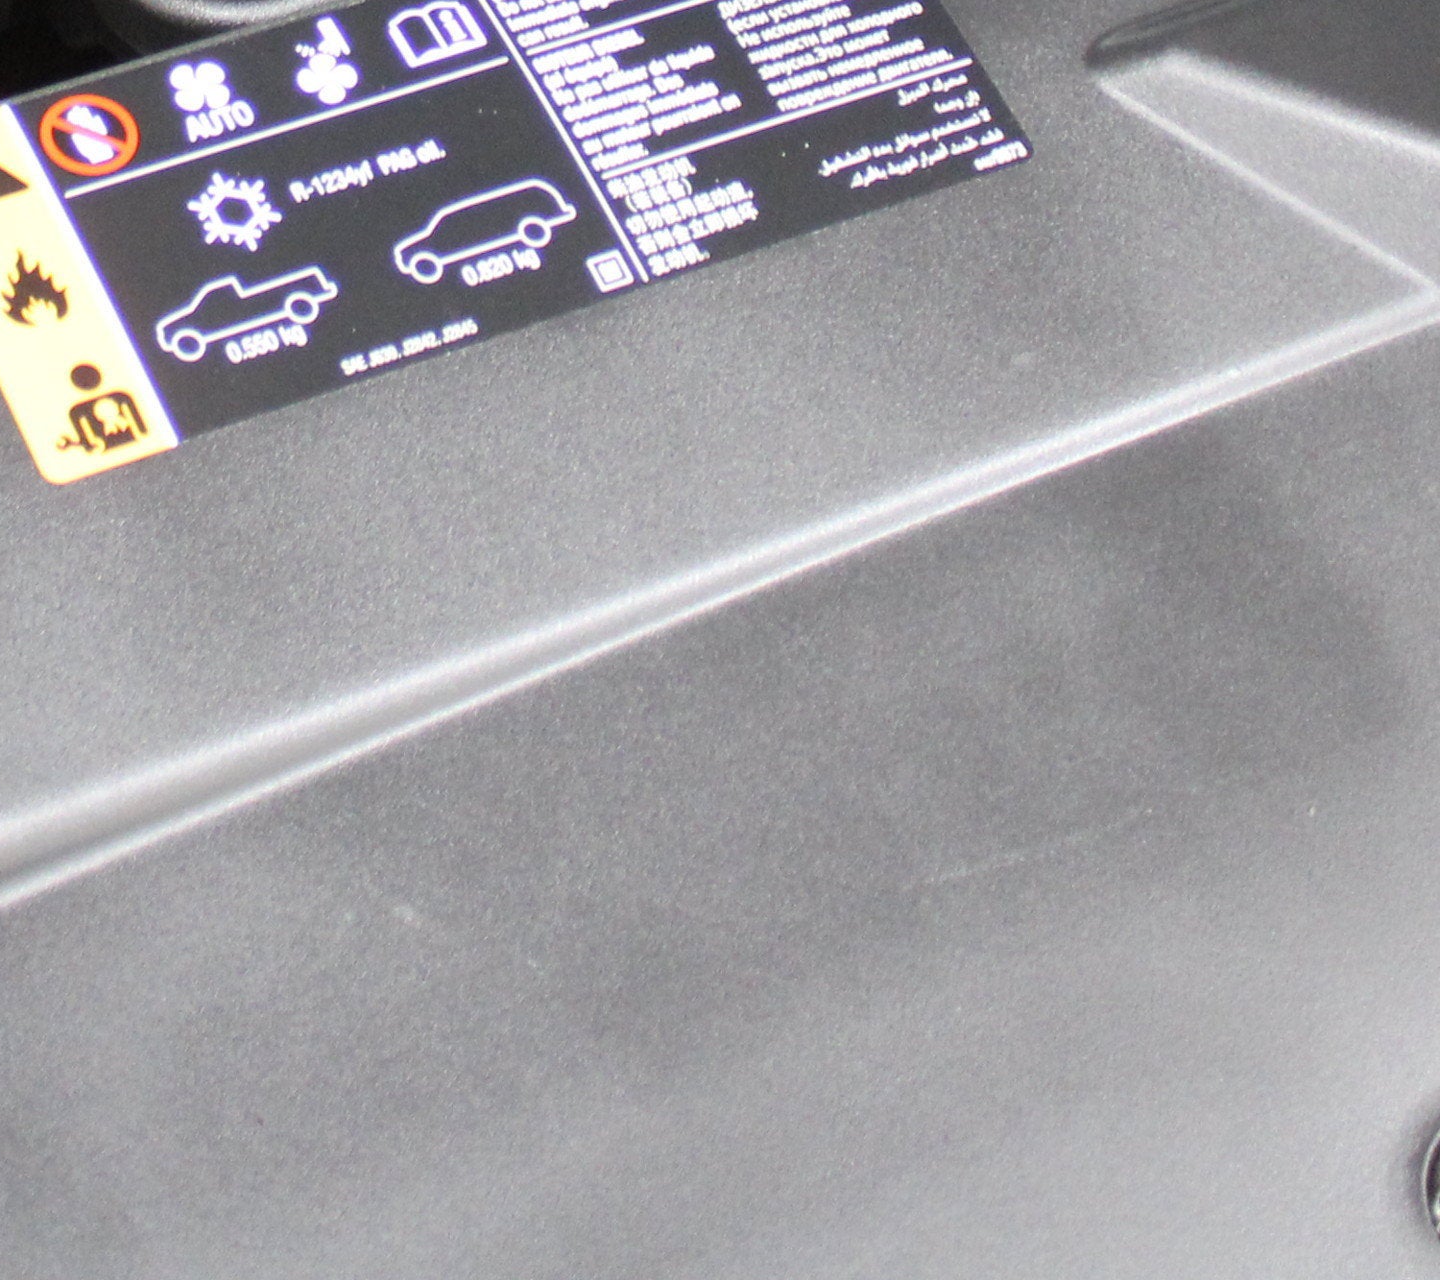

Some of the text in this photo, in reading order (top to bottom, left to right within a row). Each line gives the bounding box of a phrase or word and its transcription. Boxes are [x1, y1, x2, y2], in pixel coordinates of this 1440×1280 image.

[184, 99, 255, 143] AUTO
[510, 242, 541, 270] kg
[276, 318, 308, 347] kg
